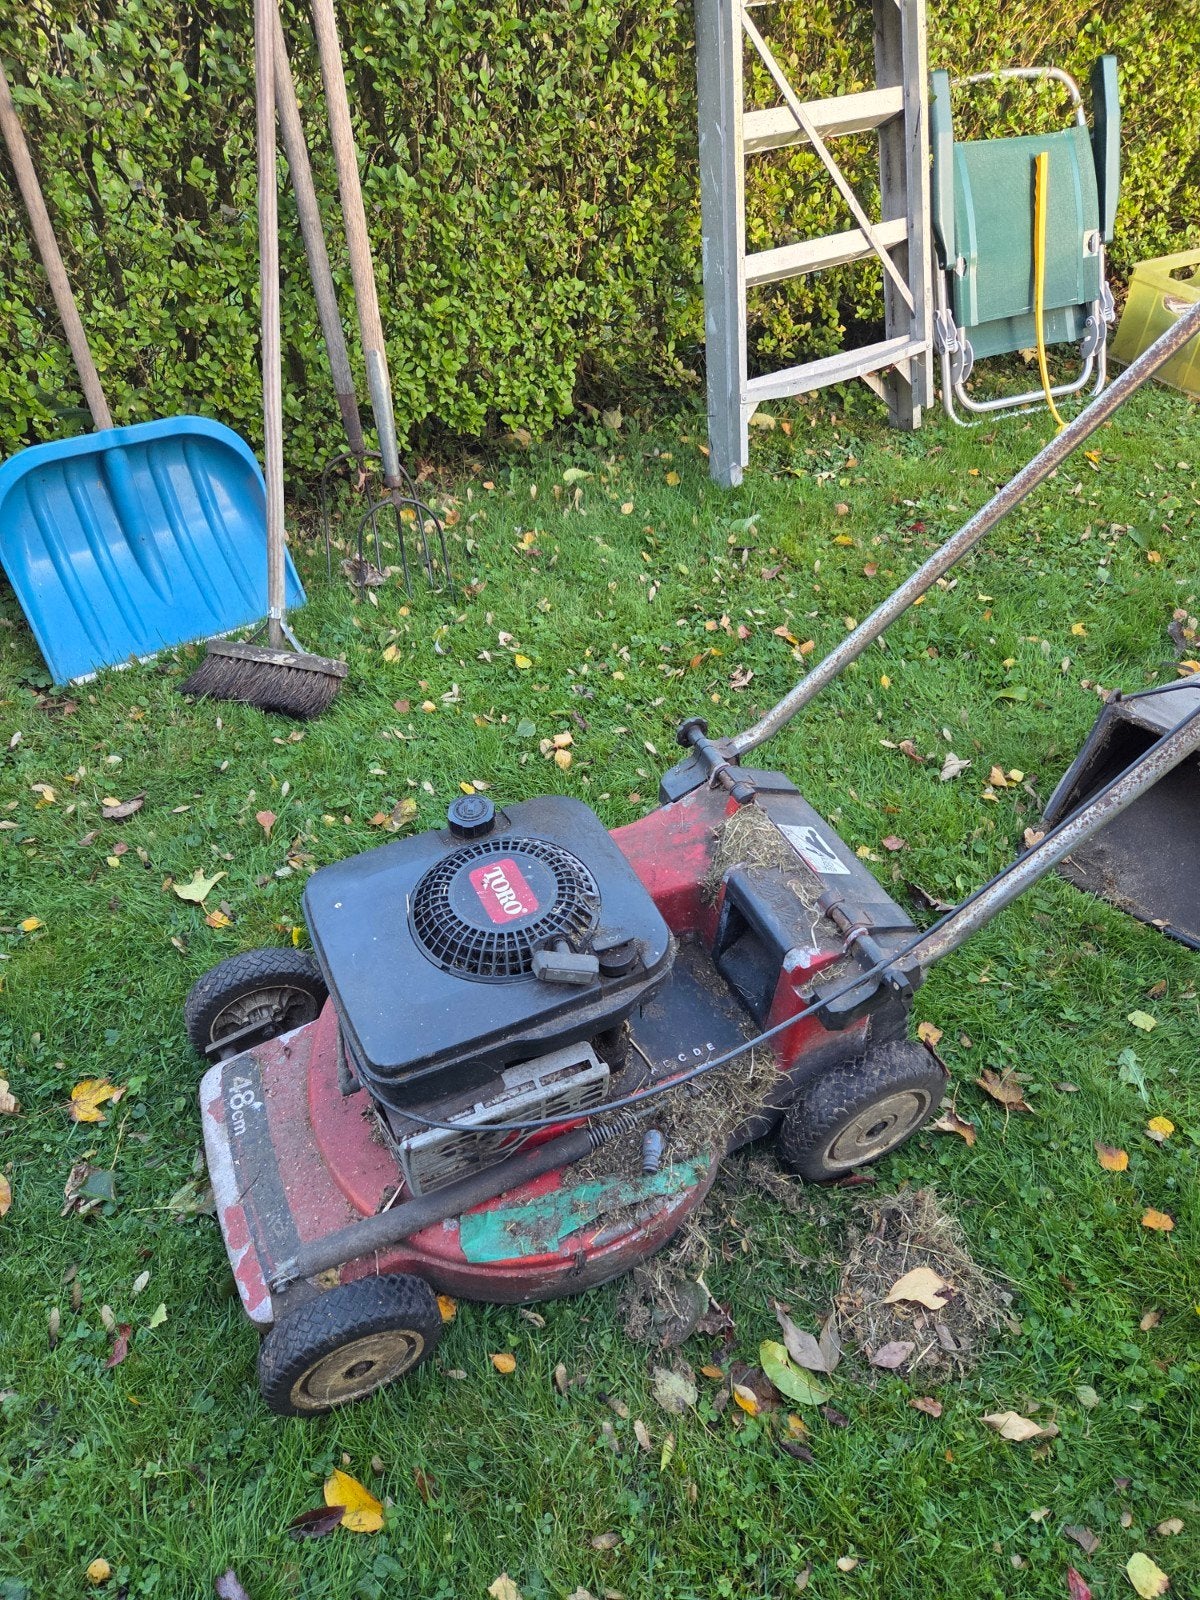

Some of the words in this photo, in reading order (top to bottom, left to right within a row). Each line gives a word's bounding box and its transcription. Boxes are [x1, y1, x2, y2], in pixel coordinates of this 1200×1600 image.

[484, 866, 523, 915] TORO
[678, 1053, 687, 1062] C
[692, 1048, 702, 1056] D
[706, 1042, 716, 1051] E
